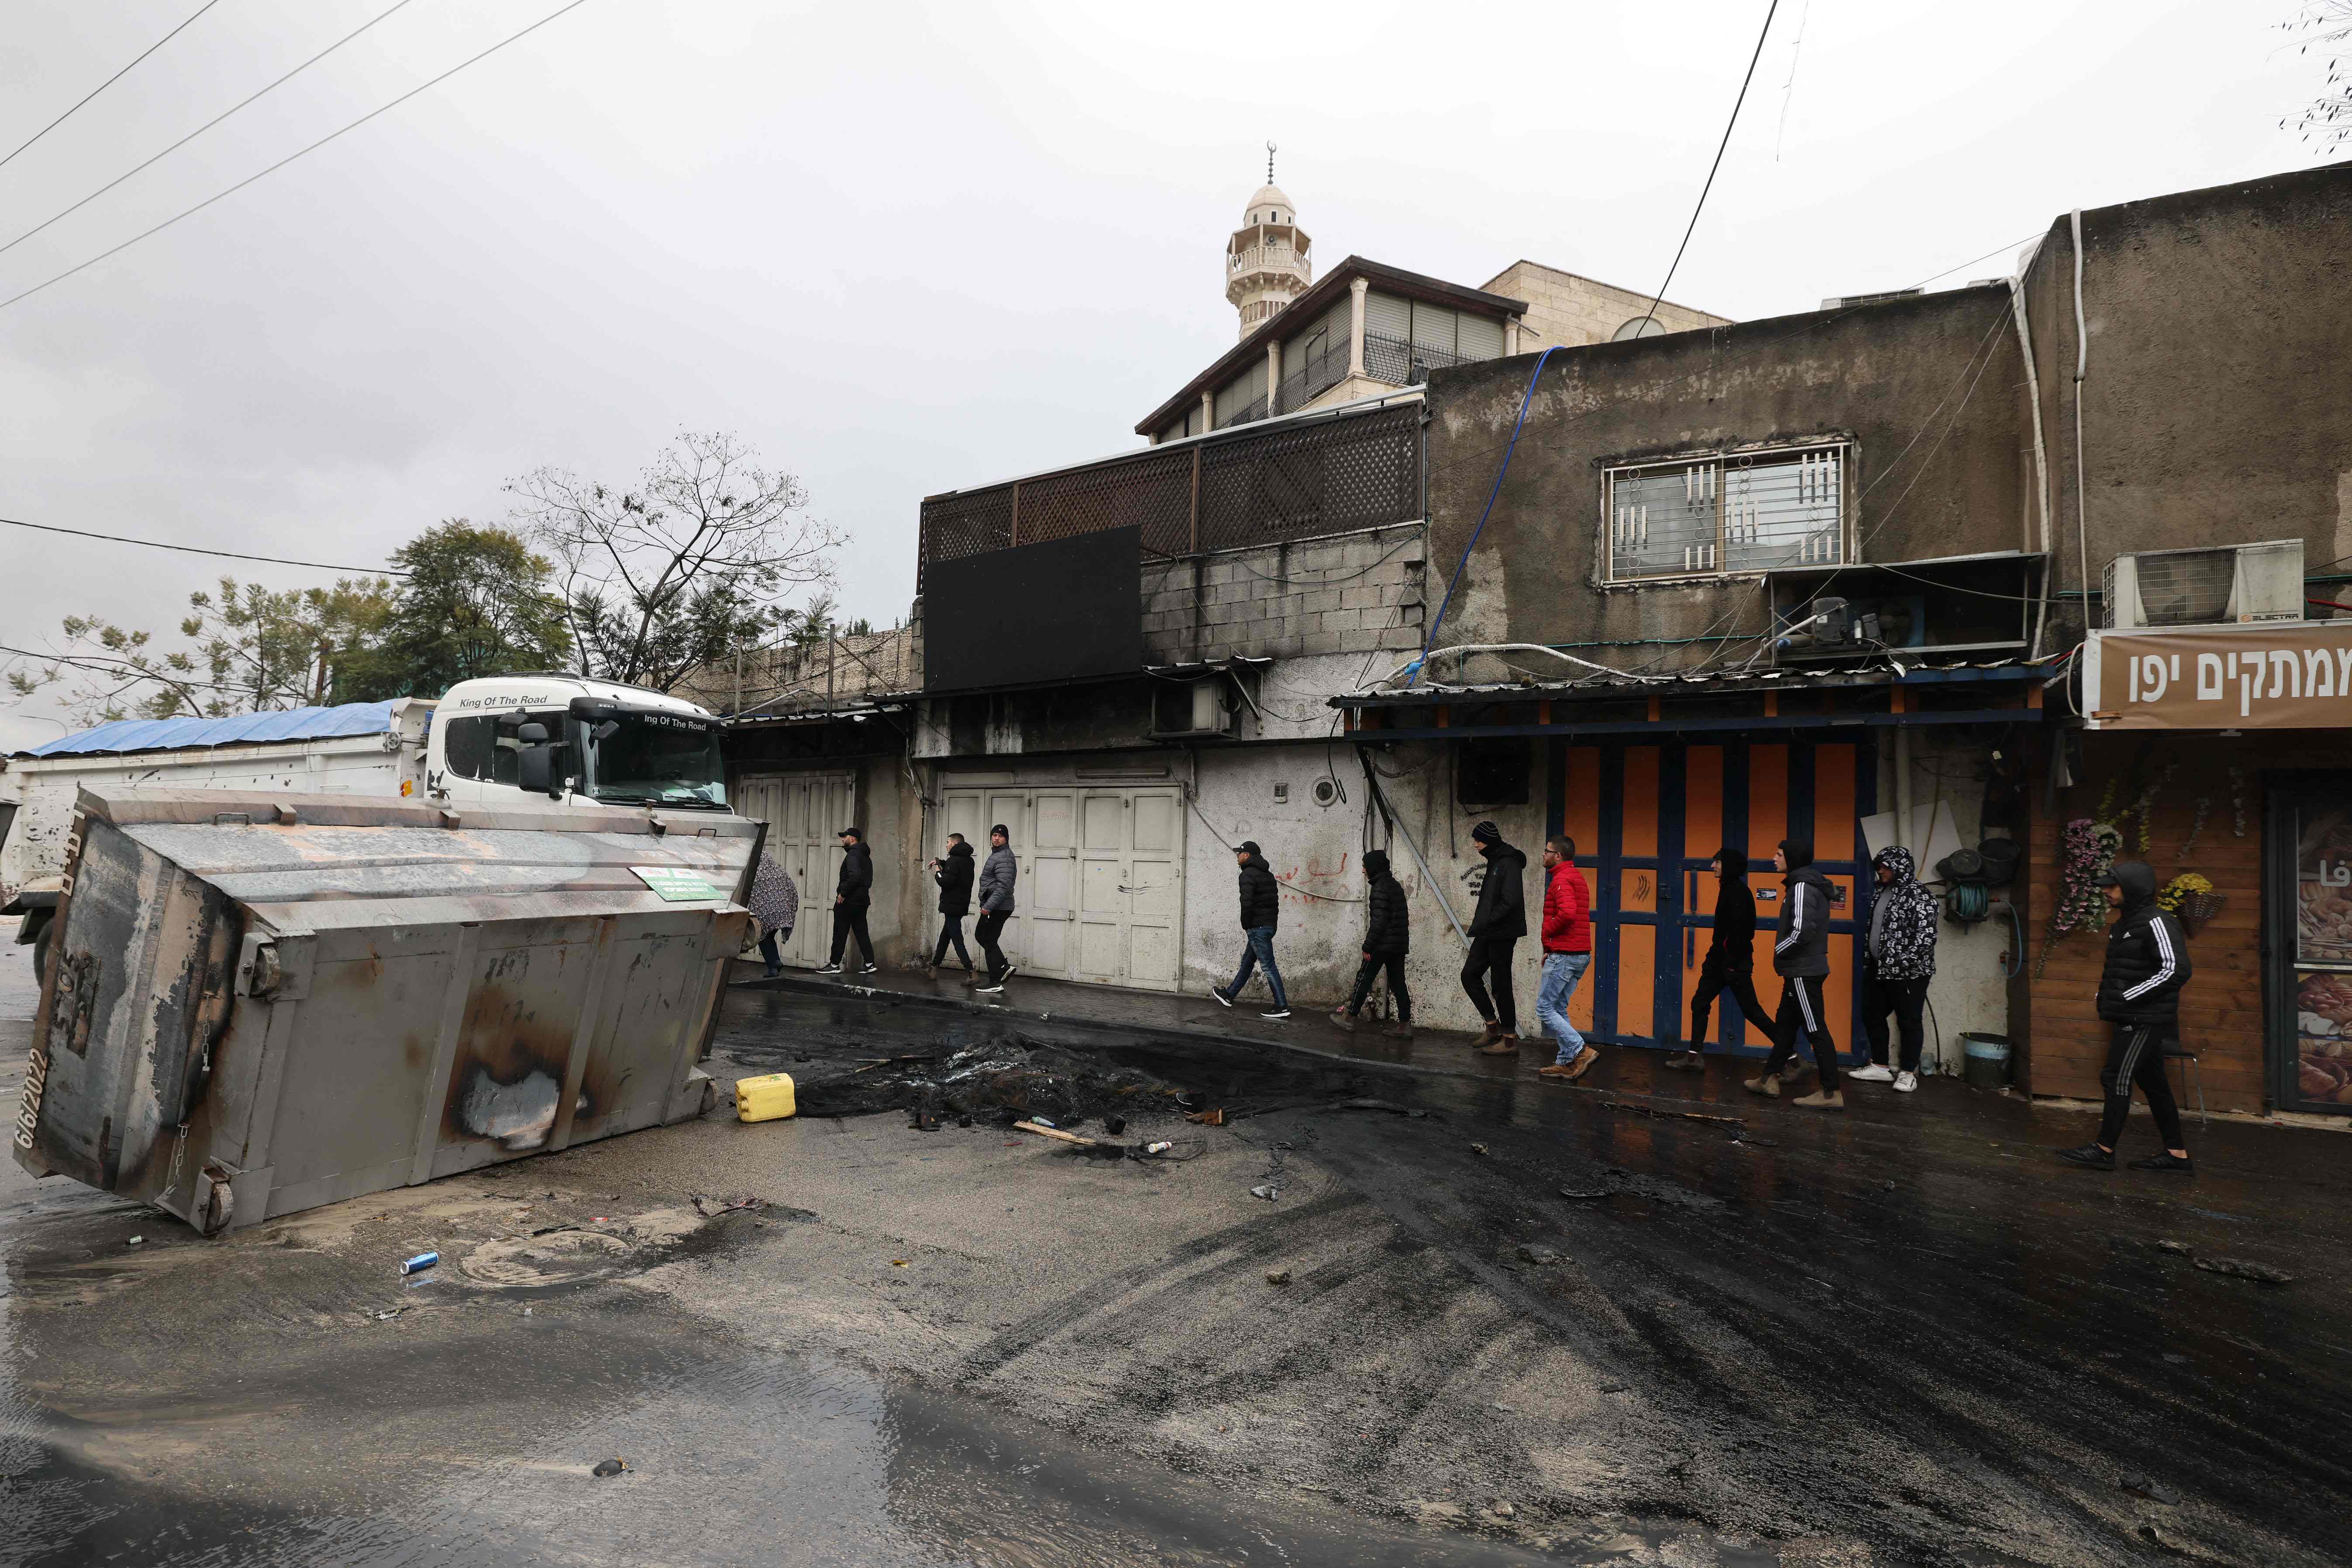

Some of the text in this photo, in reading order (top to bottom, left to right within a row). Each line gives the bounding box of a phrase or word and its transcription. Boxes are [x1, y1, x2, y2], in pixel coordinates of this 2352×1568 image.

[2129, 654, 2180, 703] יפו
[460, 695, 548, 708] King Of The Road
[644, 714, 706, 731] Ing Of The Road
[14, 1047, 48, 1150] 6/6/2022
